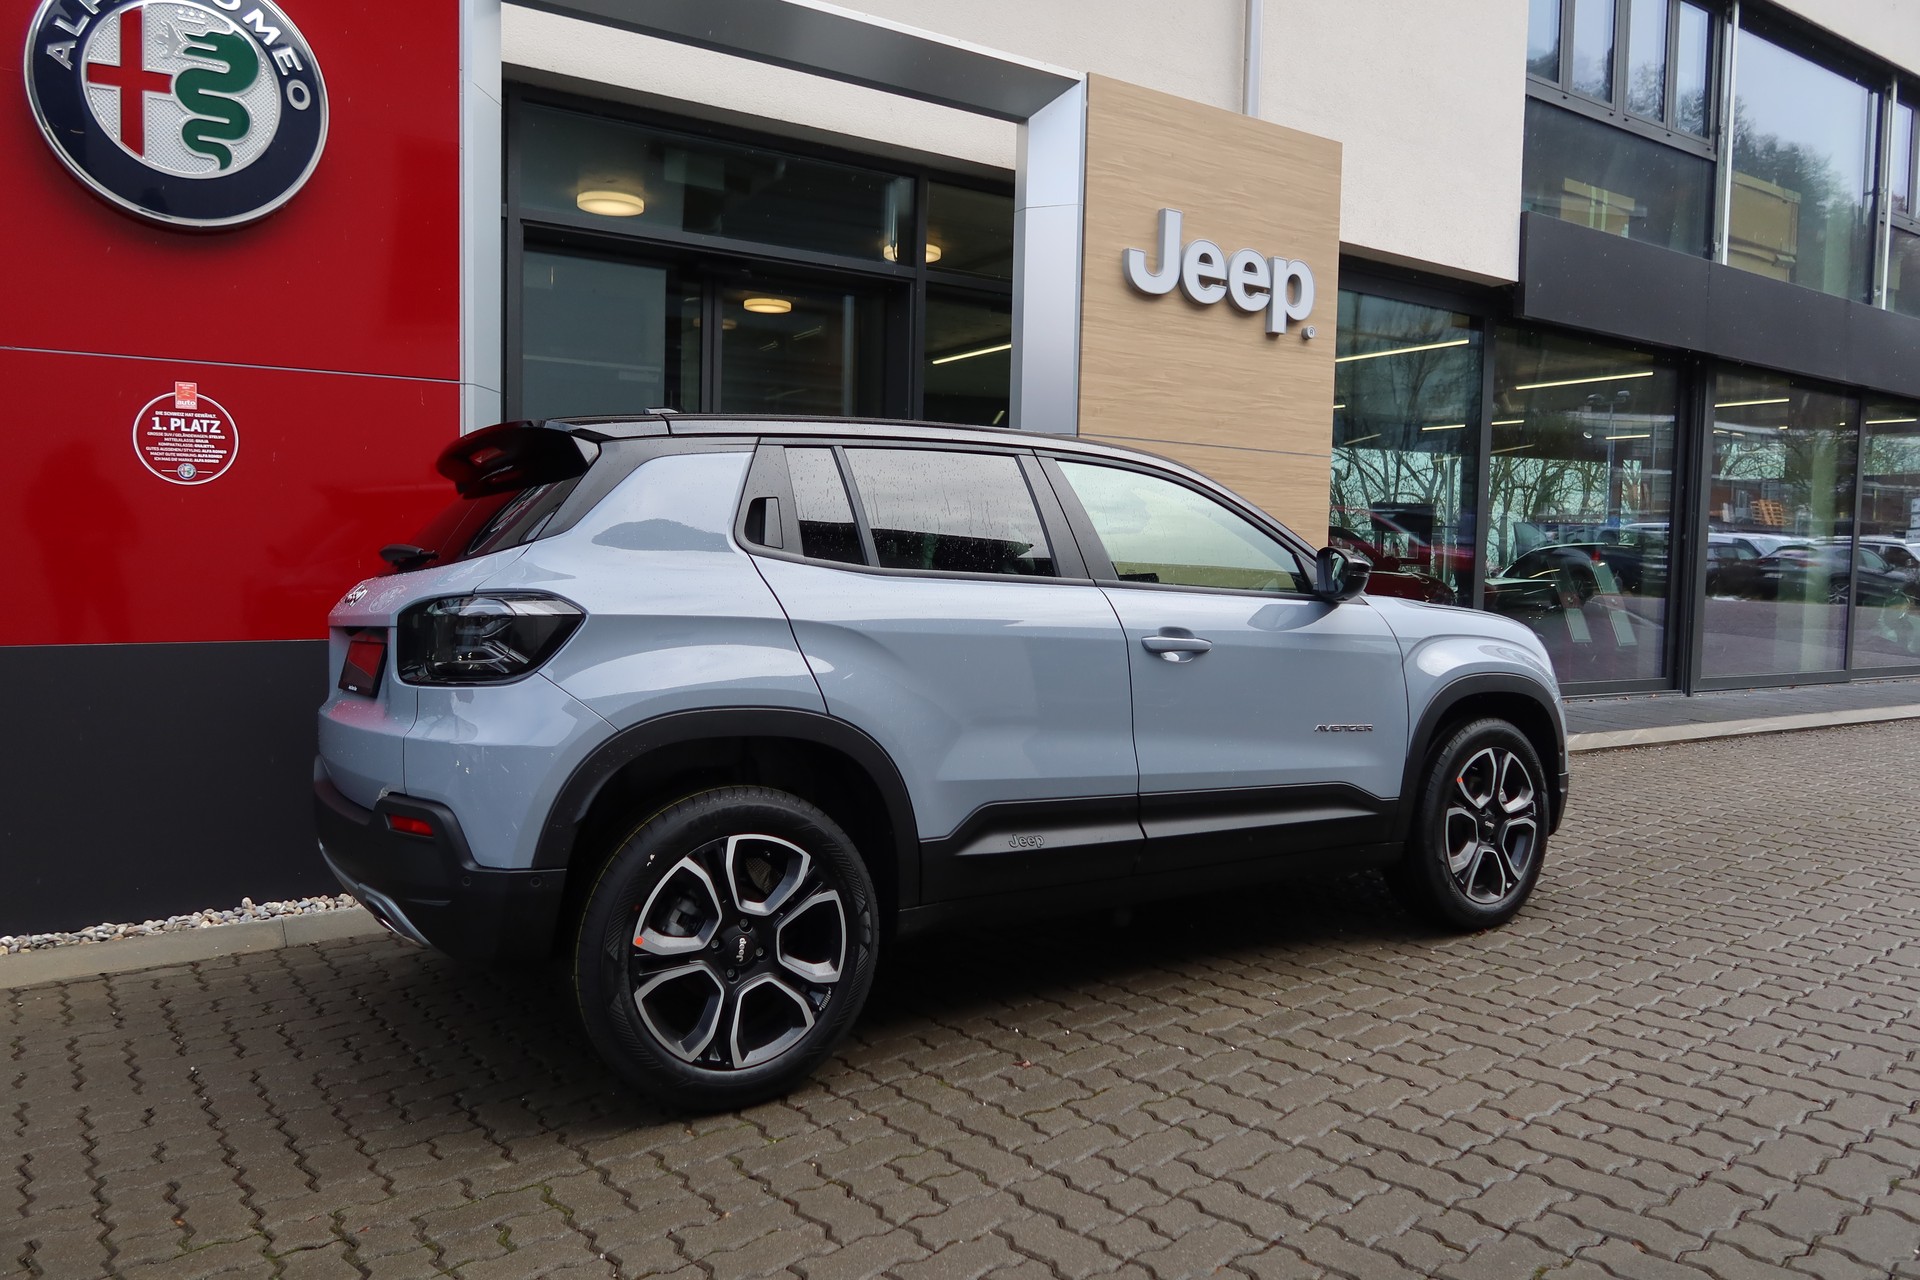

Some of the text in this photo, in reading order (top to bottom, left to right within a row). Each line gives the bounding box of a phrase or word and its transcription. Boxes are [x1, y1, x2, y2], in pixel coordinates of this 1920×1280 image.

[1122, 208, 1315, 335] Jeep
[152, 416, 221, 433] 1. PLATZ
[1314, 723, 1373, 732] AVENGER
[1008, 834, 1044, 848] Jeep
[736, 938, 747, 962] Jeep
